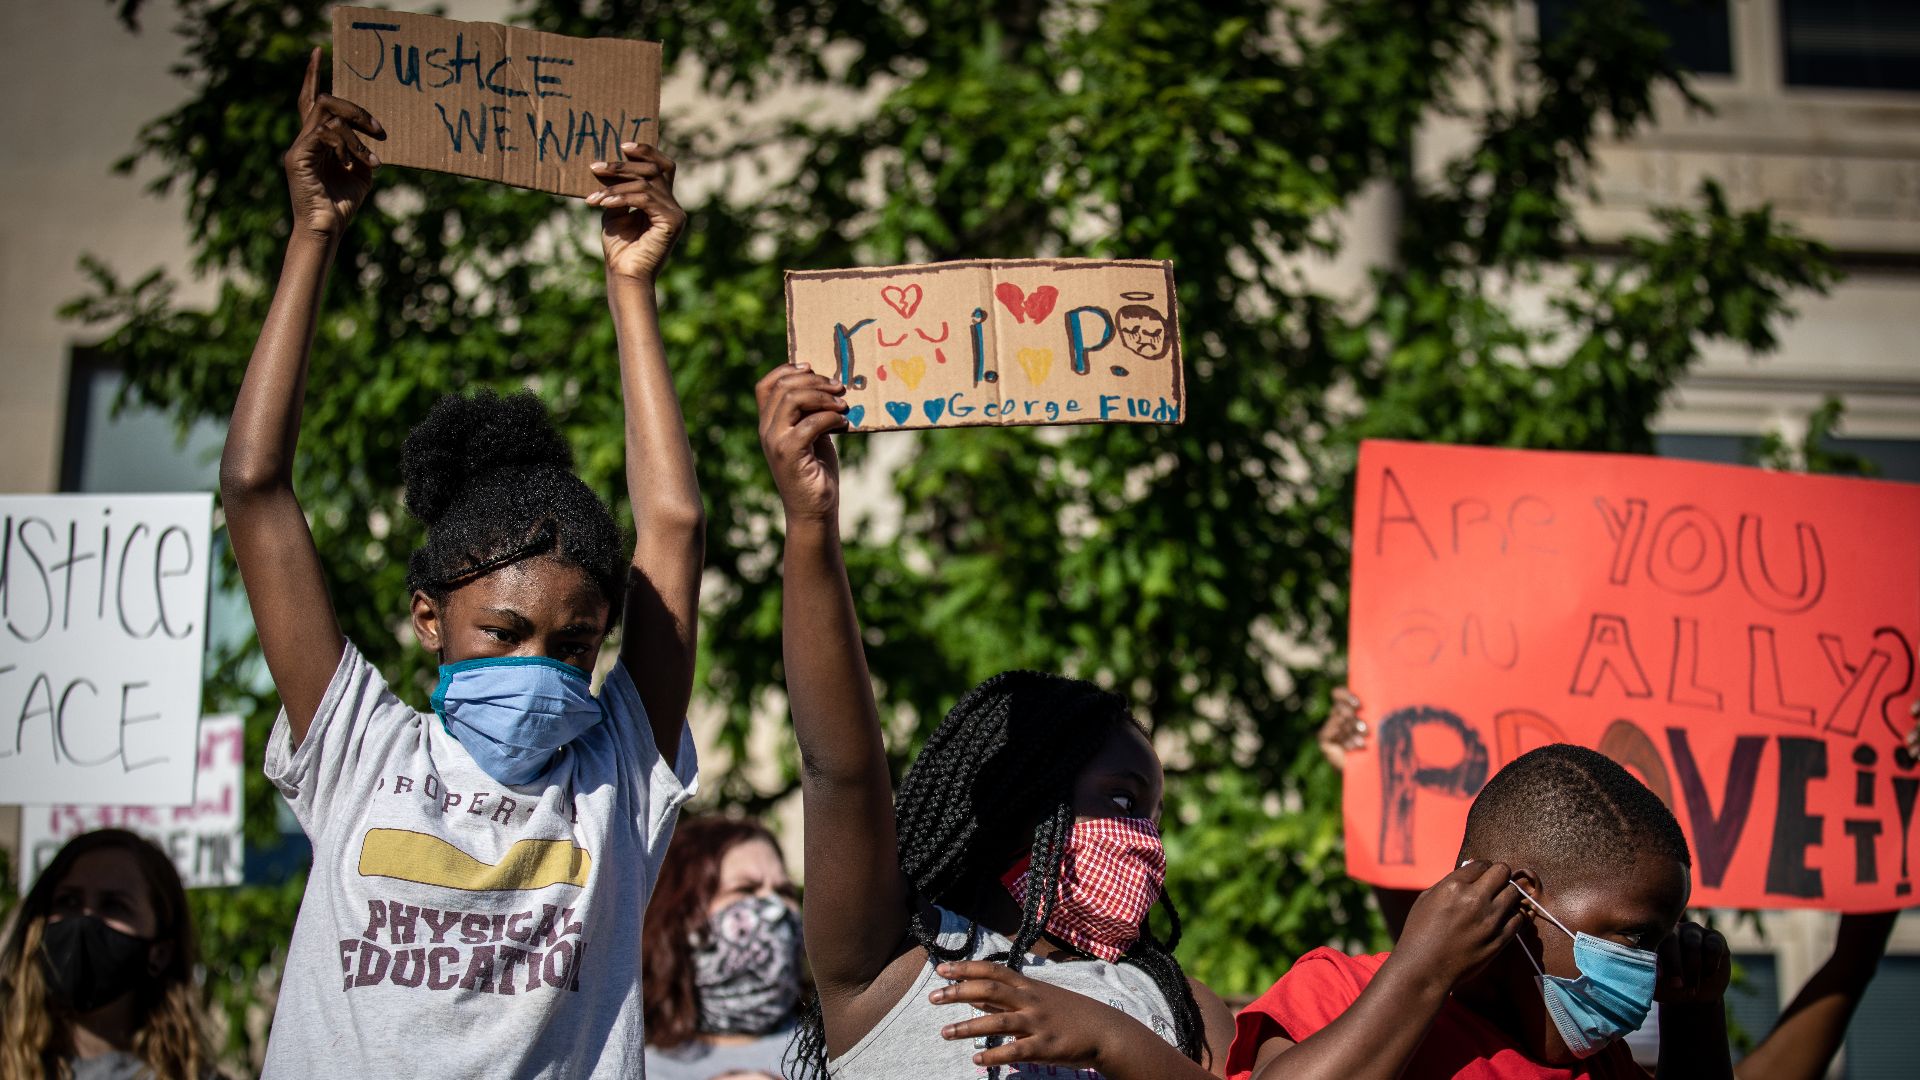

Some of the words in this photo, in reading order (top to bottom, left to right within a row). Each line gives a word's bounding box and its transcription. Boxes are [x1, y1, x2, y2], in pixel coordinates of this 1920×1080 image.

[435, 102, 519, 154] WE
[526, 107, 652, 162] WANT
[1593, 498, 1827, 614] YOU
[0, 664, 170, 773] ACE
[377, 772, 534, 826] ROPER
[362, 899, 583, 945] PHYSICAL
